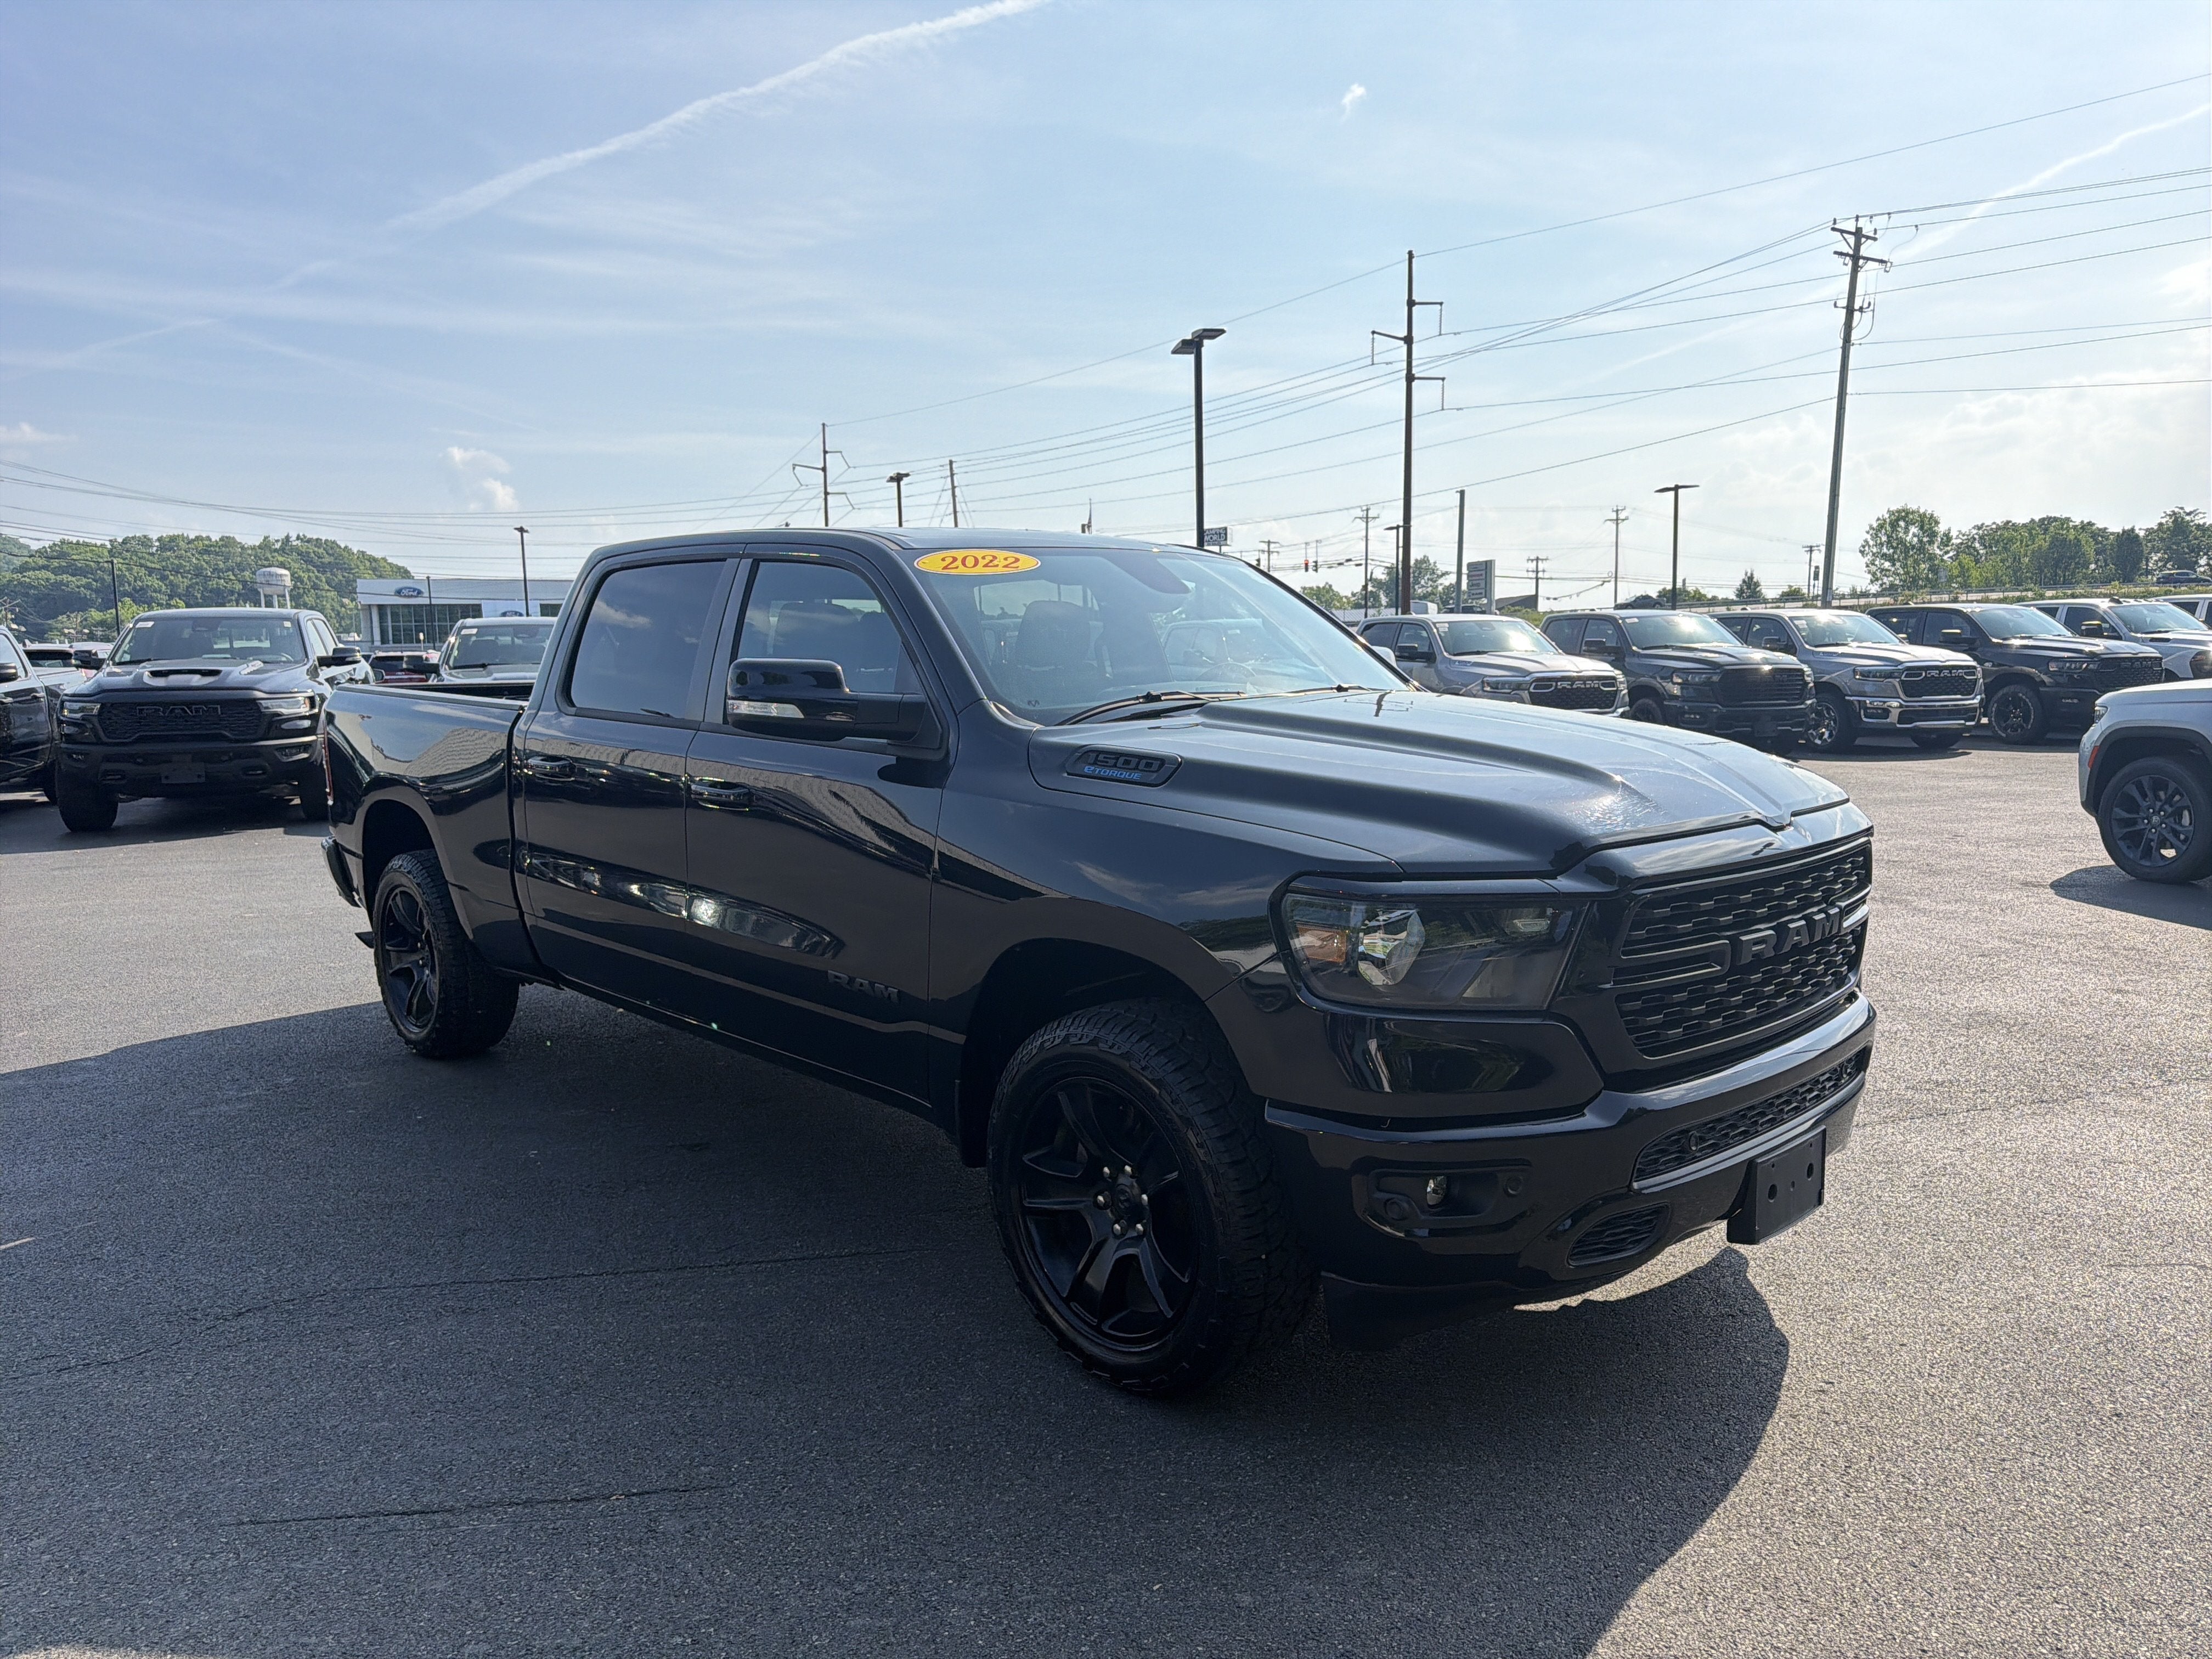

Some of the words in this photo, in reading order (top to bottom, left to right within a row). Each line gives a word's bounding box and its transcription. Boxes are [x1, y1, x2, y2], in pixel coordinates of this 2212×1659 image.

[941, 555, 1020, 570] 2022
[137, 705, 221, 716] RAM
[1087, 753, 1160, 771] 1500
[1084, 766, 1142, 780] eTORQUE
[1736, 907, 1840, 965] RAM
[828, 970, 899, 1003] RAM
